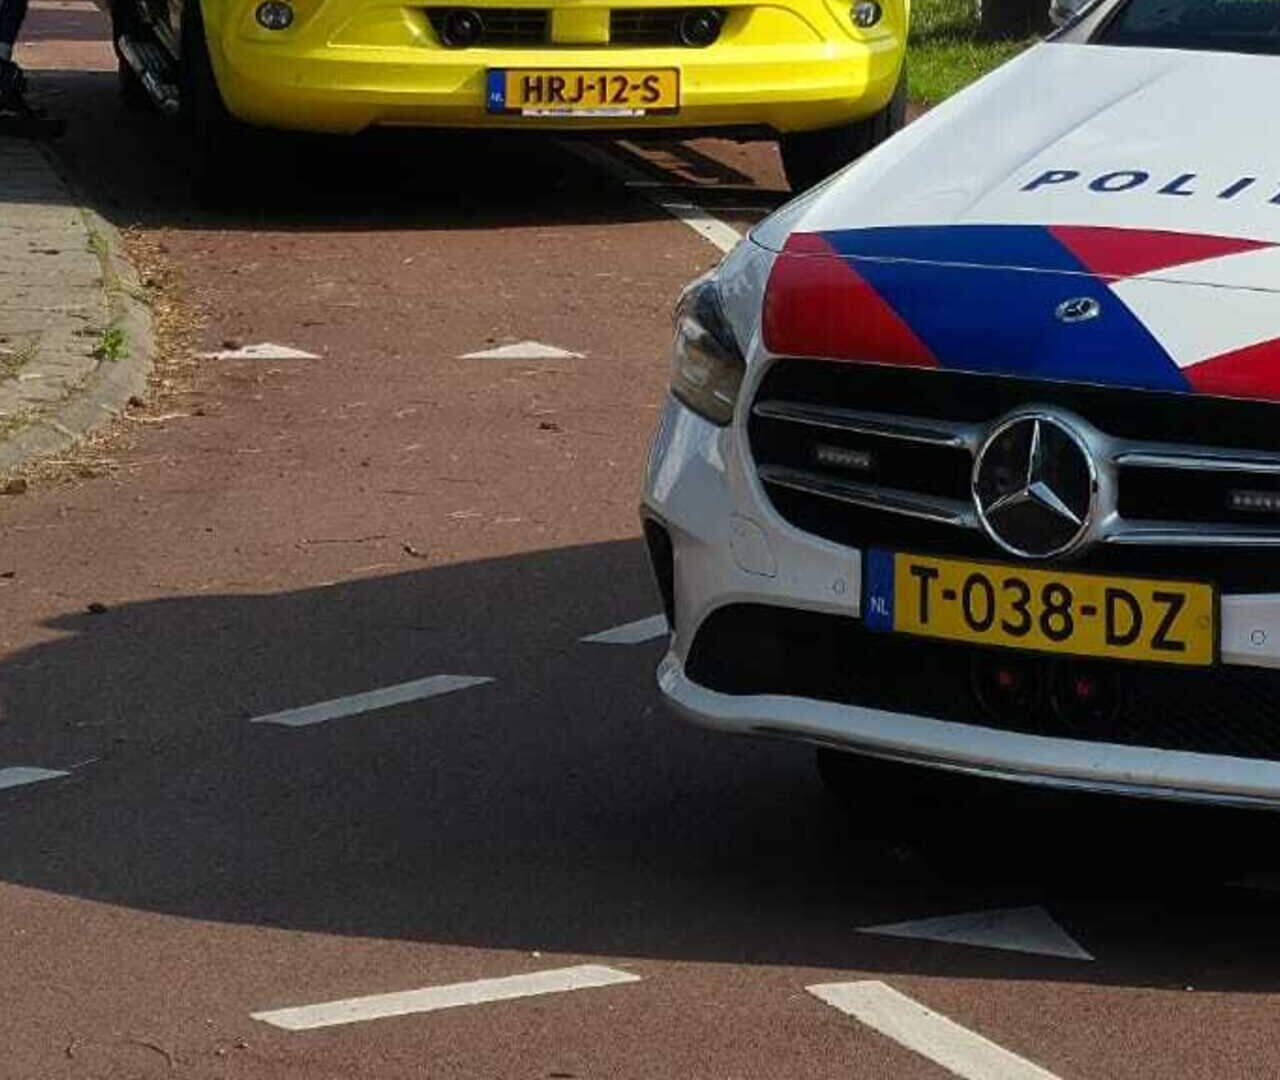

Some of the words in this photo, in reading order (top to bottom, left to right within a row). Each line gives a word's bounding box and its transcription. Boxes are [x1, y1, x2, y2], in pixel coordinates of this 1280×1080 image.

[523, 74, 661, 104] HRJ-12-S
[870, 595, 889, 616] NL
[909, 564, 1187, 652] T-038-DZ
